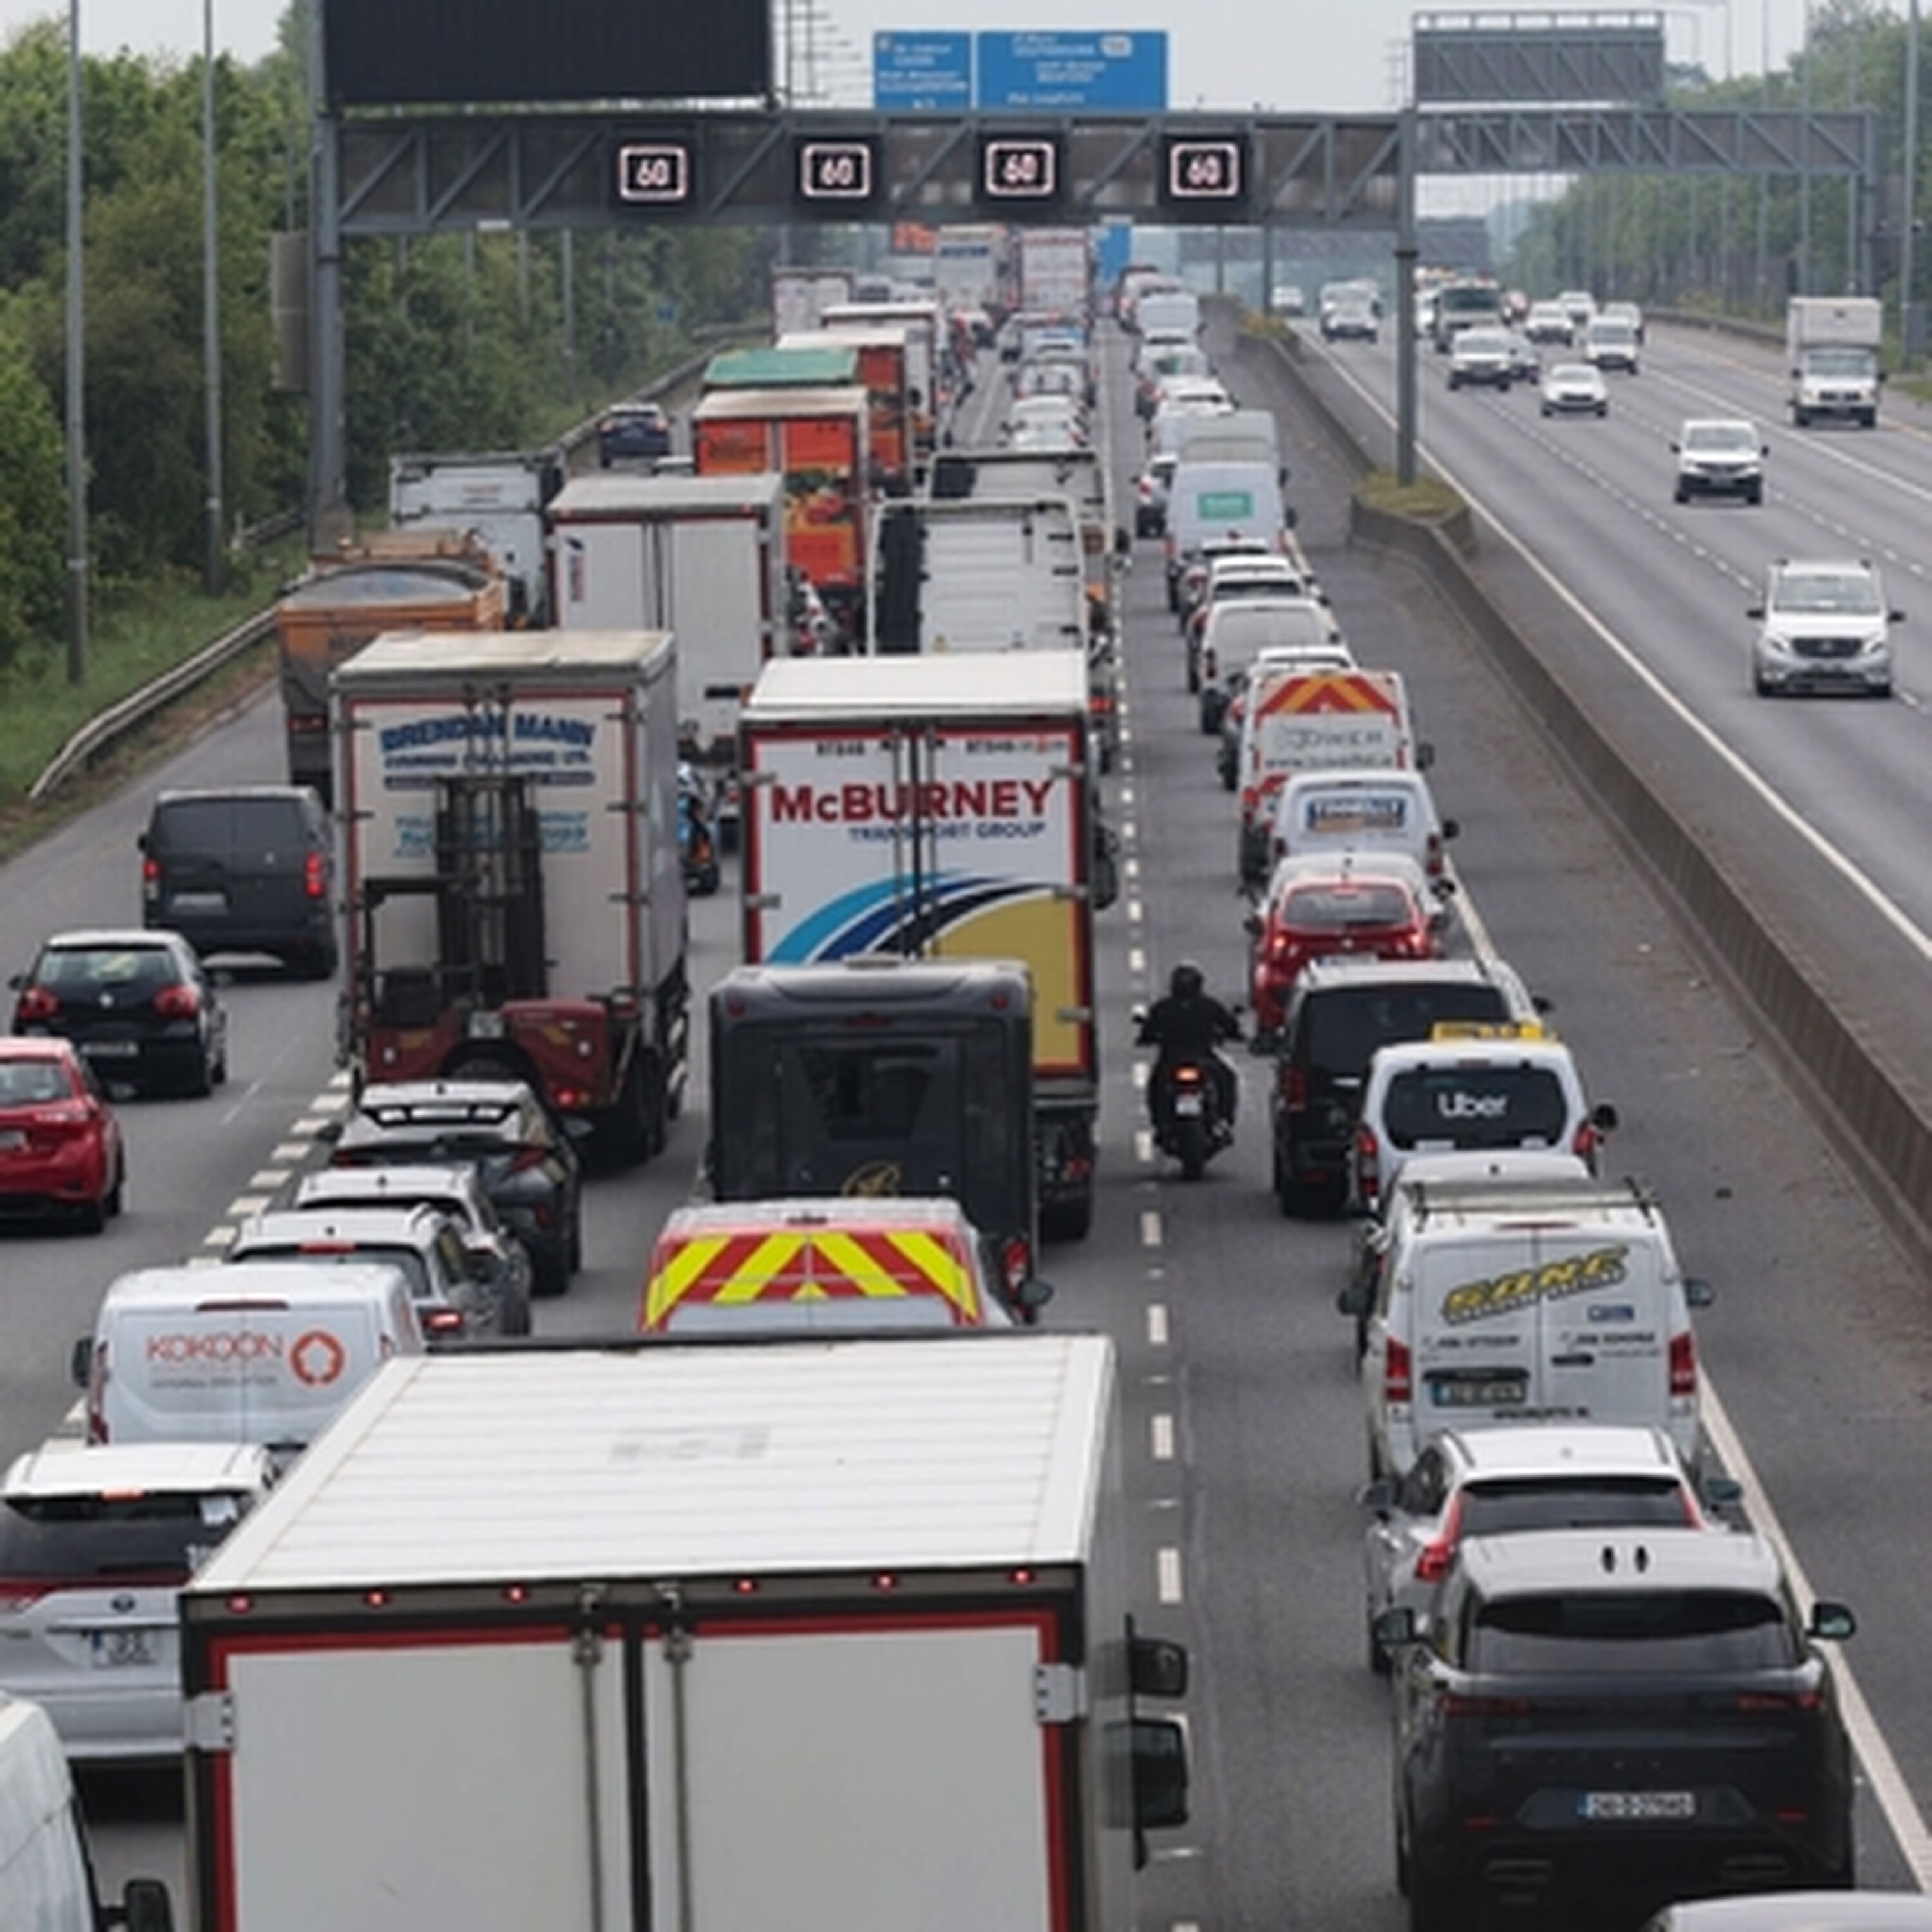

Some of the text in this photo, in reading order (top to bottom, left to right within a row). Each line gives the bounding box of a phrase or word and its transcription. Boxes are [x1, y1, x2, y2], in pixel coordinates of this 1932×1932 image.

[636, 158, 669, 186] 60
[821, 157, 853, 185] 60
[1004, 155, 1037, 183] 60
[1188, 156, 1220, 185] 60
[381, 714, 596, 752] BRENDAN MANN
[772, 780, 1055, 822] McBURNEY
[976, 822, 1045, 840] GROUP
[1437, 1092, 1508, 1118] Uber
